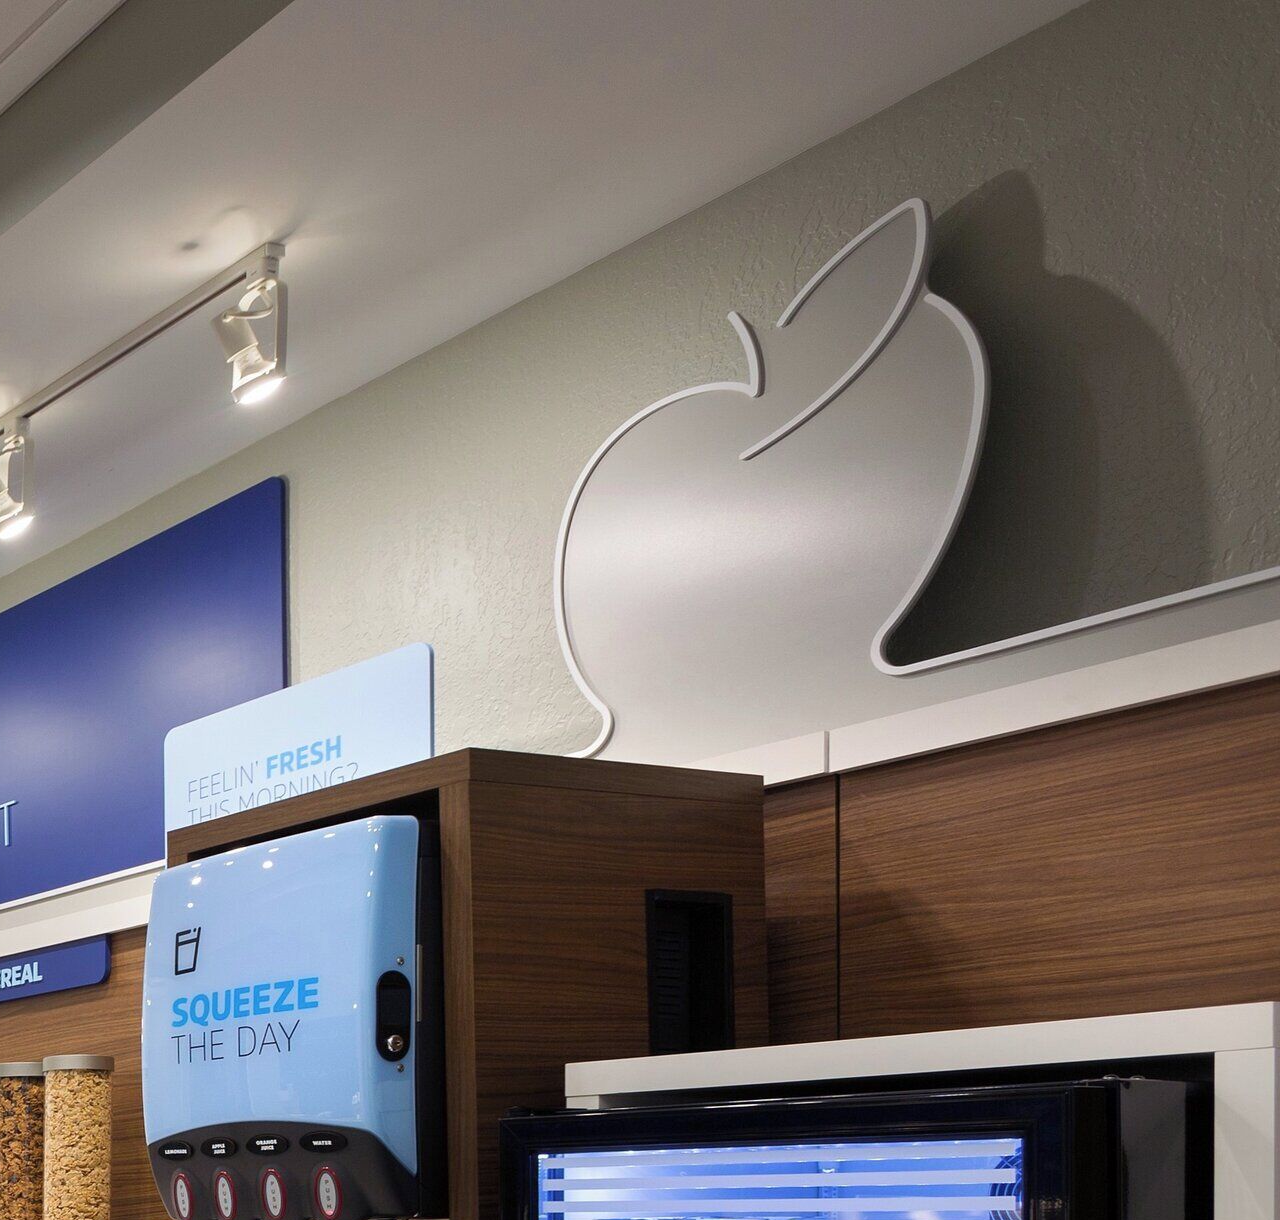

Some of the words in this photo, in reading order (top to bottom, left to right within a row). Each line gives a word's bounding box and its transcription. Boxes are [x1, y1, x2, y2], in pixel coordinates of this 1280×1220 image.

[188, 760, 259, 803] FEELIN'
[266, 735, 342, 779] FRESH
[171, 976, 320, 1029] SQUEEZE
[171, 1028, 225, 1065] THE
[237, 1018, 301, 1059] DAY
[270, 1180, 278, 1210] PUSH
[324, 1179, 333, 1210] PUSH
